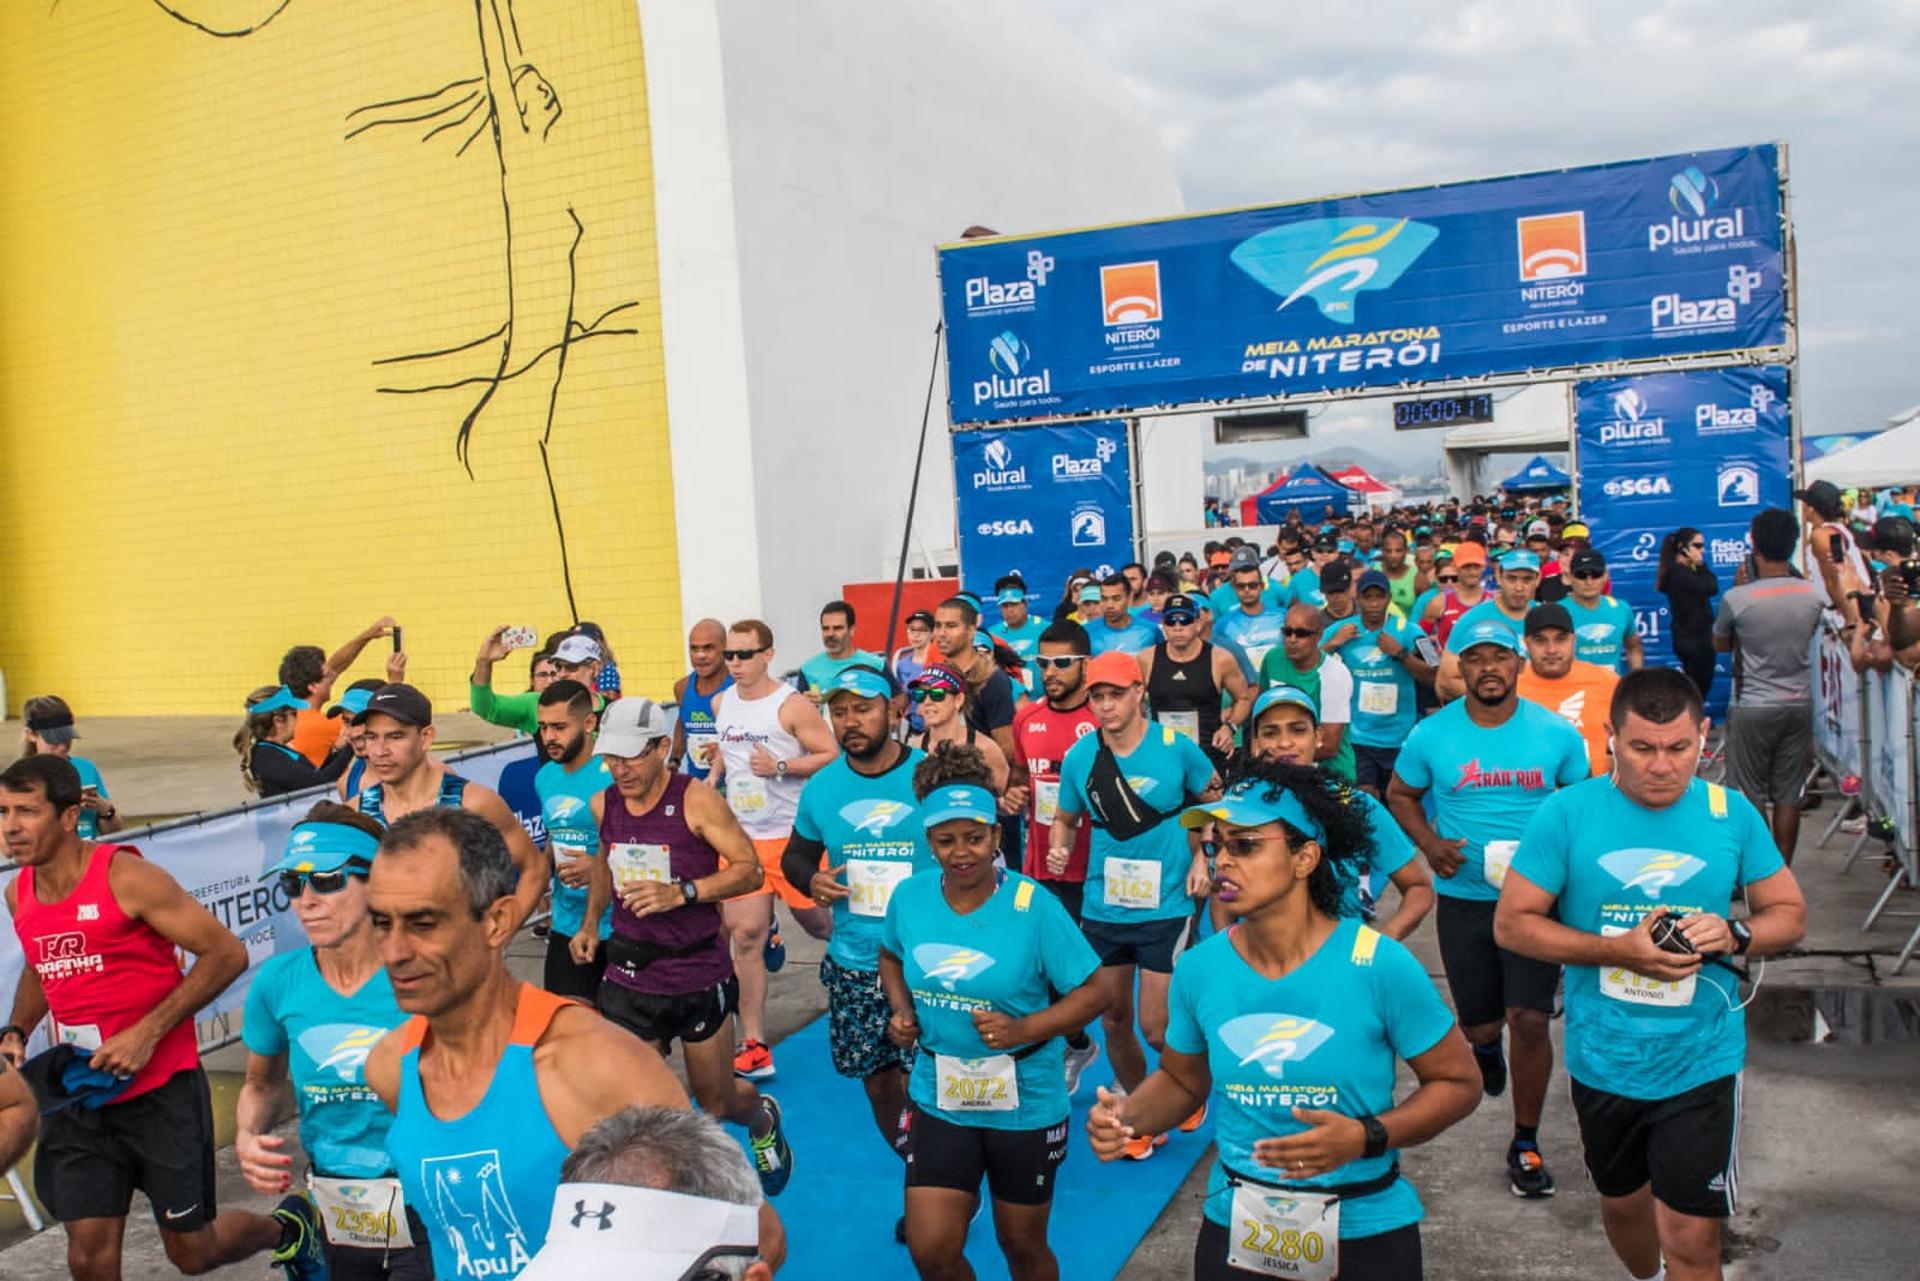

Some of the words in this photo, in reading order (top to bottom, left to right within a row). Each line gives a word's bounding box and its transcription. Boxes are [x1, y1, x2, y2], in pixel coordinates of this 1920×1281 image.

[1649, 208, 1743, 252] plural
[966, 276, 1036, 307] Plaza
[1521, 280, 1584, 303] NITERÓI
[1651, 293, 1737, 327] Plaza
[1105, 326, 1160, 345] NITERÓI
[1502, 320, 1556, 334] ESPORTE
[1558, 319, 1566, 328] E
[1567, 314, 1608, 327] LAZER
[1244, 339, 1301, 357] MEIA
[1306, 325, 1441, 351] MARATONA
[1089, 362, 1137, 375] ESPORTE
[1138, 361, 1145, 371] E
[1146, 356, 1182, 369] LAZER
[1241, 359, 1268, 374] DE
[1269, 340, 1442, 379] NITERÓI
[973, 368, 1051, 406] plural
[1395, 396, 1490, 425] 00:00:17
[1696, 403, 1758, 428] Plaza
[1600, 417, 1665, 445] plural
[1052, 453, 1103, 476] Plaza
[973, 466, 1027, 489] plural
[1028, 722, 1047, 733] BRA
[248, 924, 276, 946] VOCÊ
[1624, 987, 1665, 999] ANTONIO
[944, 1074, 1008, 1100] 2072
[330, 1204, 398, 1237] 2390
[1241, 1218, 1325, 1264] 2280
[1262, 1256, 1300, 1273] JESSICA
